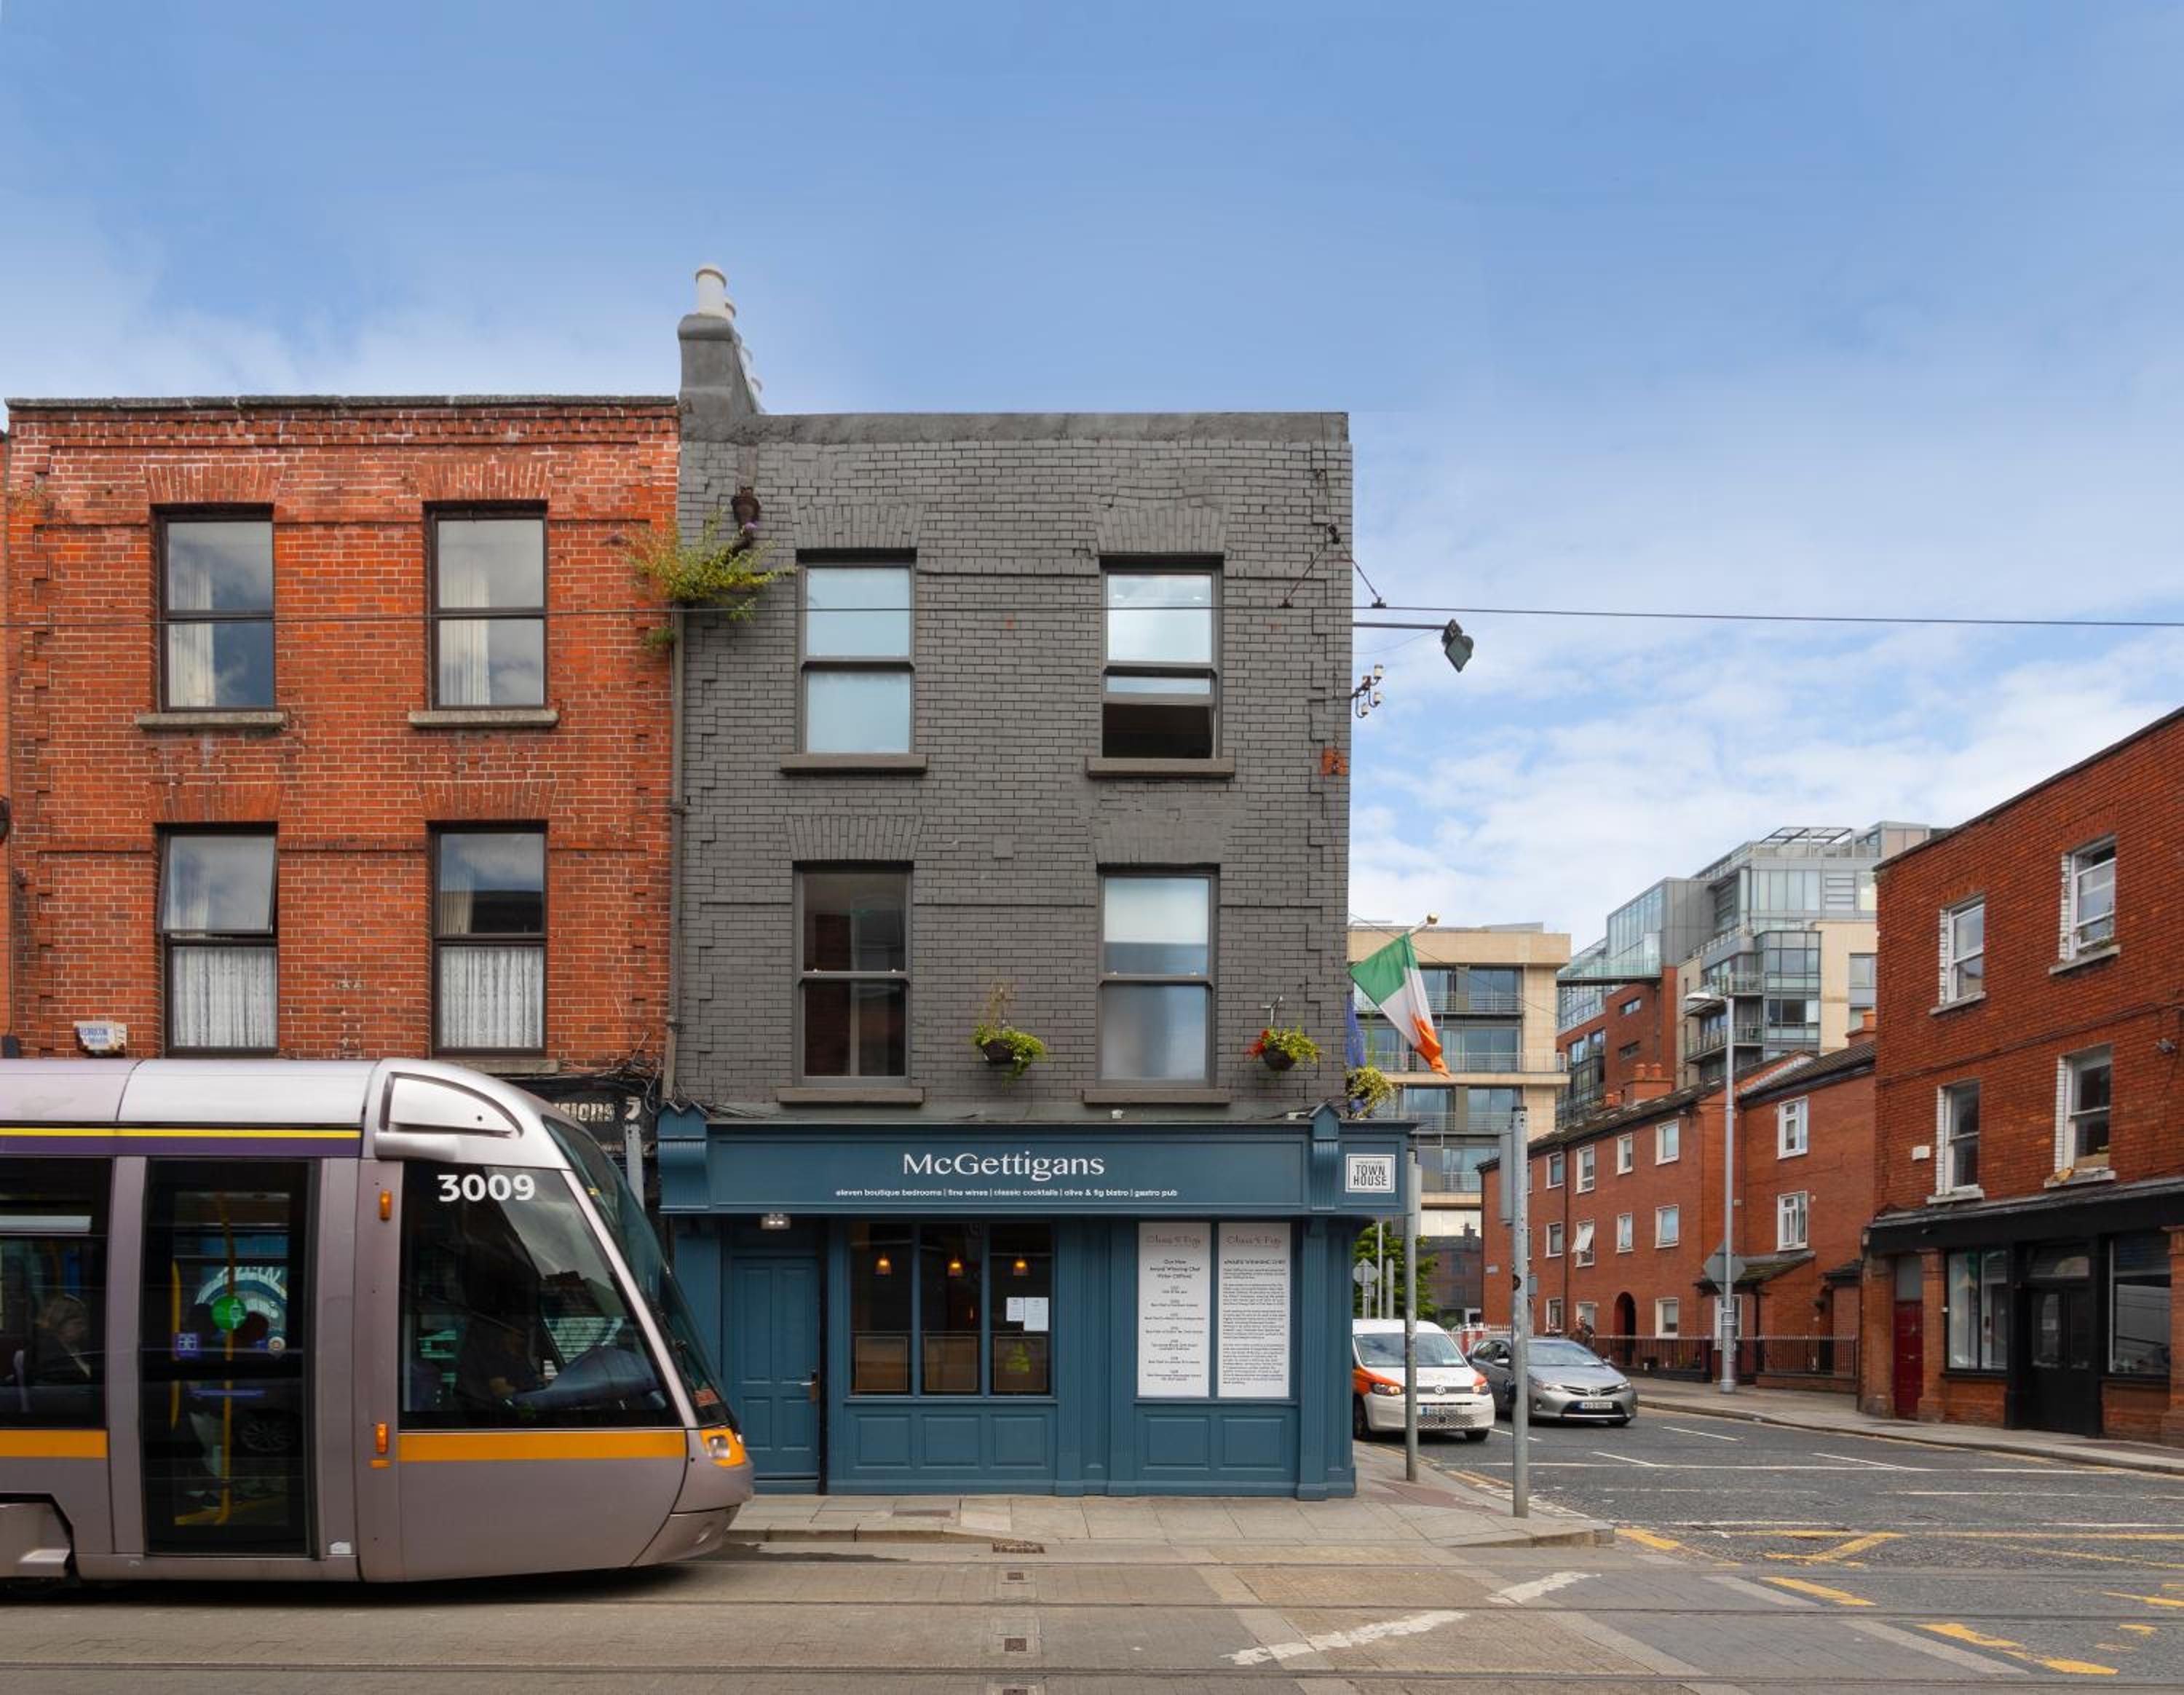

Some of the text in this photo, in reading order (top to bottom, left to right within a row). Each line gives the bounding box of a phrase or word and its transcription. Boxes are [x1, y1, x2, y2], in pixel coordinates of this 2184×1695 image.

[903, 1151, 1105, 1182] McGettigans
[1355, 1165, 1385, 1176] TOWN
[1353, 1175, 1387, 1186] HOUSE
[438, 1174, 536, 1202] 3009
[864, 1188, 900, 1198] boutique
[902, 1188, 942, 1196] bedrooms
[948, 1188, 963, 1196] fine
[994, 1188, 1021, 1196] classic
[1023, 1188, 1059, 1196] cocktails
[1064, 1188, 1083, 1196] olive
[1093, 1188, 1104, 1198] fig
[1106, 1188, 1129, 1196] bistro
[1135, 1189, 1160, 1198] gastro
[1161, 1188, 1178, 1198] pub
